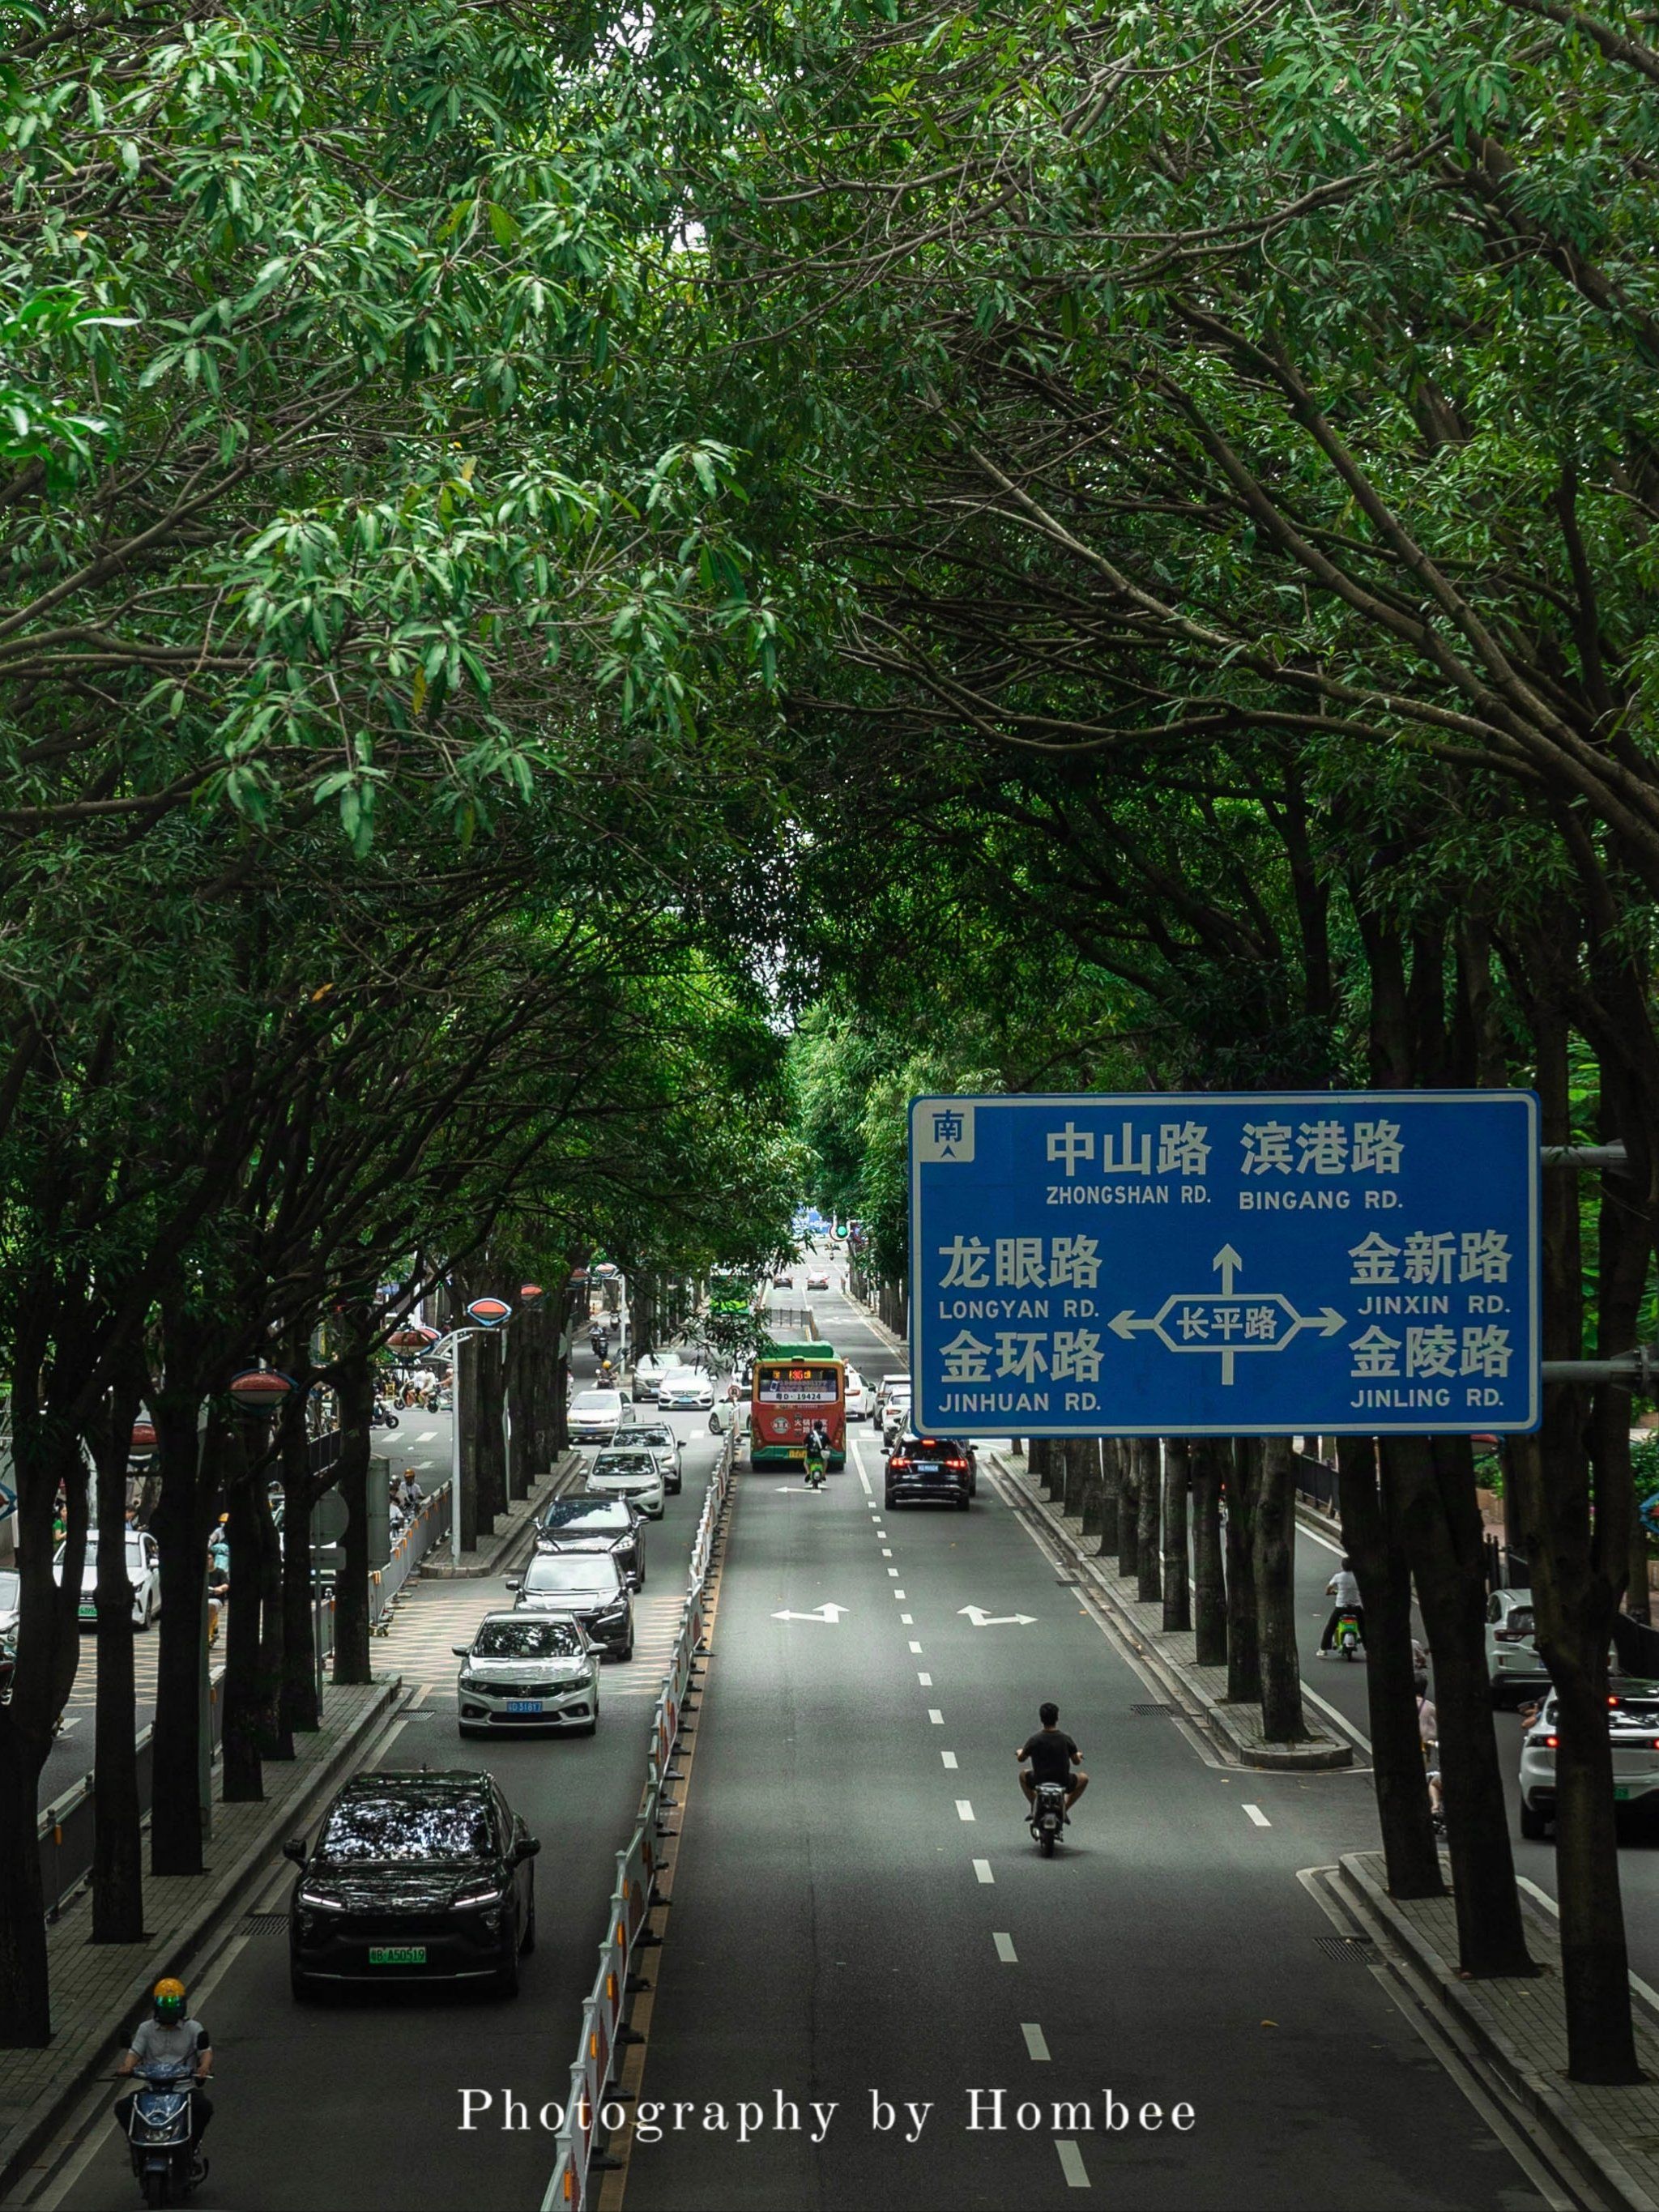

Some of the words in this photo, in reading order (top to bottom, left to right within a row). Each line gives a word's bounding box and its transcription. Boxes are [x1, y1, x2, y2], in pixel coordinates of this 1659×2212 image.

[932, 1109, 965, 1144] 南
[1047, 1121, 1213, 1177] 中山路
[1240, 1119, 1405, 1176] 滨港路
[1047, 1186, 1169, 1205] ZHONGSHAN
[1181, 1186, 1212, 1204] RD.
[1239, 1191, 1351, 1211] BINGANG
[1365, 1191, 1404, 1209] RD.
[939, 1234, 1103, 1289] 龙眼路
[1349, 1230, 1513, 1285] 金新路
[940, 1300, 1049, 1319] LONGYAN
[1064, 1300, 1100, 1319] RD.
[1358, 1296, 1449, 1315] JINXIN
[1469, 1296, 1511, 1314] RD.
[1177, 1307, 1278, 1340] 长平路
[940, 1329, 1105, 1384] 金环路
[1350, 1324, 1514, 1379] 金陵路
[938, 1392, 1050, 1413] JINHUAN
[1065, 1392, 1102, 1412] RD.
[1350, 1388, 1451, 1409] JINLING
[1467, 1388, 1504, 1407] RD.
